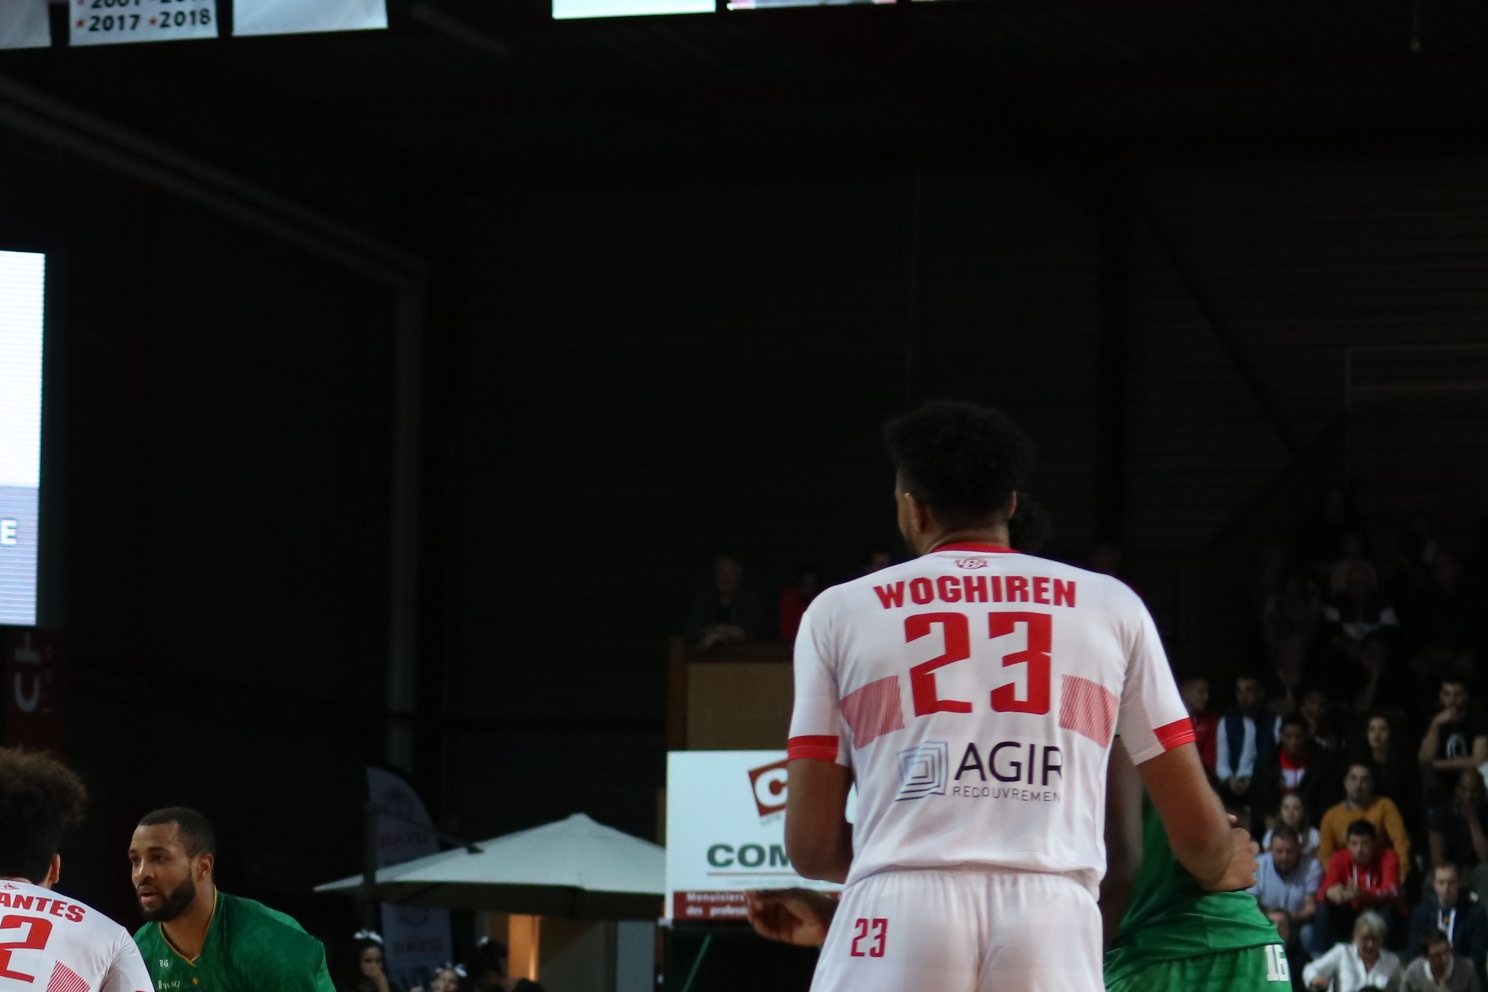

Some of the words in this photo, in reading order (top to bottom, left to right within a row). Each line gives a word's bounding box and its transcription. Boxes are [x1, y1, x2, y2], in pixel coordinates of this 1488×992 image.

[88, 14, 140, 32] 2017
[160, 8, 211, 28] 2018
[873, 575, 1077, 610] WOGHIREN
[904, 611, 1053, 718] 23
[850, 918, 889, 957] 23
